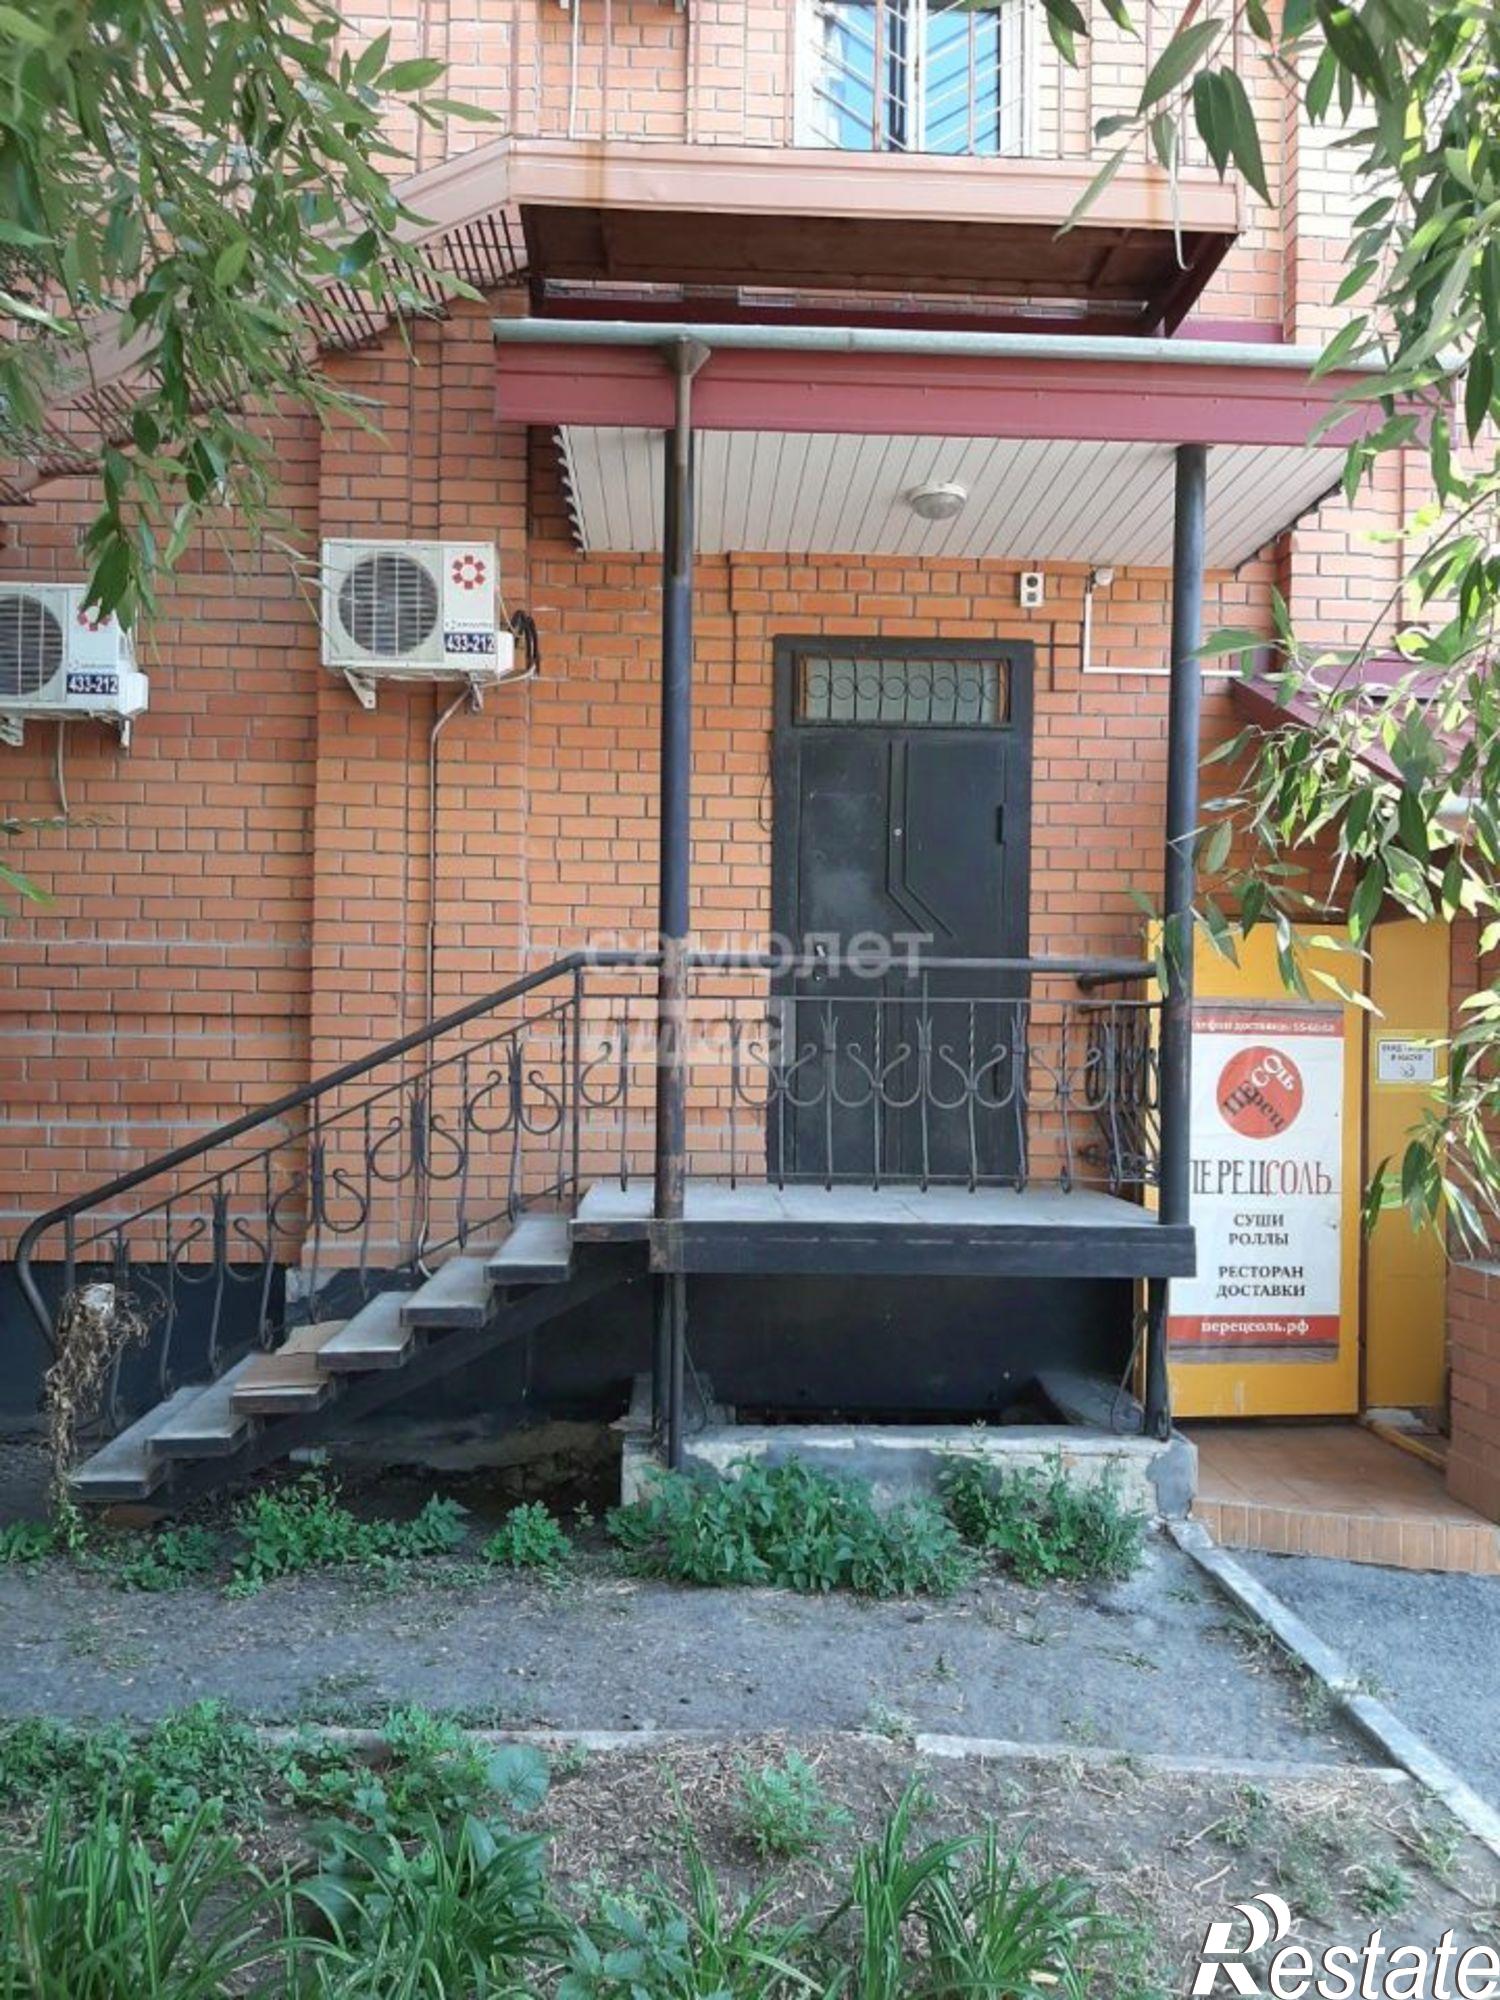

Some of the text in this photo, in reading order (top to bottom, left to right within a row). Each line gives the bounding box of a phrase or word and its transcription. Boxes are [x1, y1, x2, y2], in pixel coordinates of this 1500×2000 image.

[69, 676, 118, 693] 433-212
[1233, 1213, 1284, 1227] СУШИ
[1228, 1232, 1289, 1246] РОЛЛЫ
[1218, 1265, 1304, 1278] РЕСТОРАН
[1216, 1284, 1306, 1299] ДОСТАВКИ
[1201, 1318, 1309, 1336] перецсоль.рф
